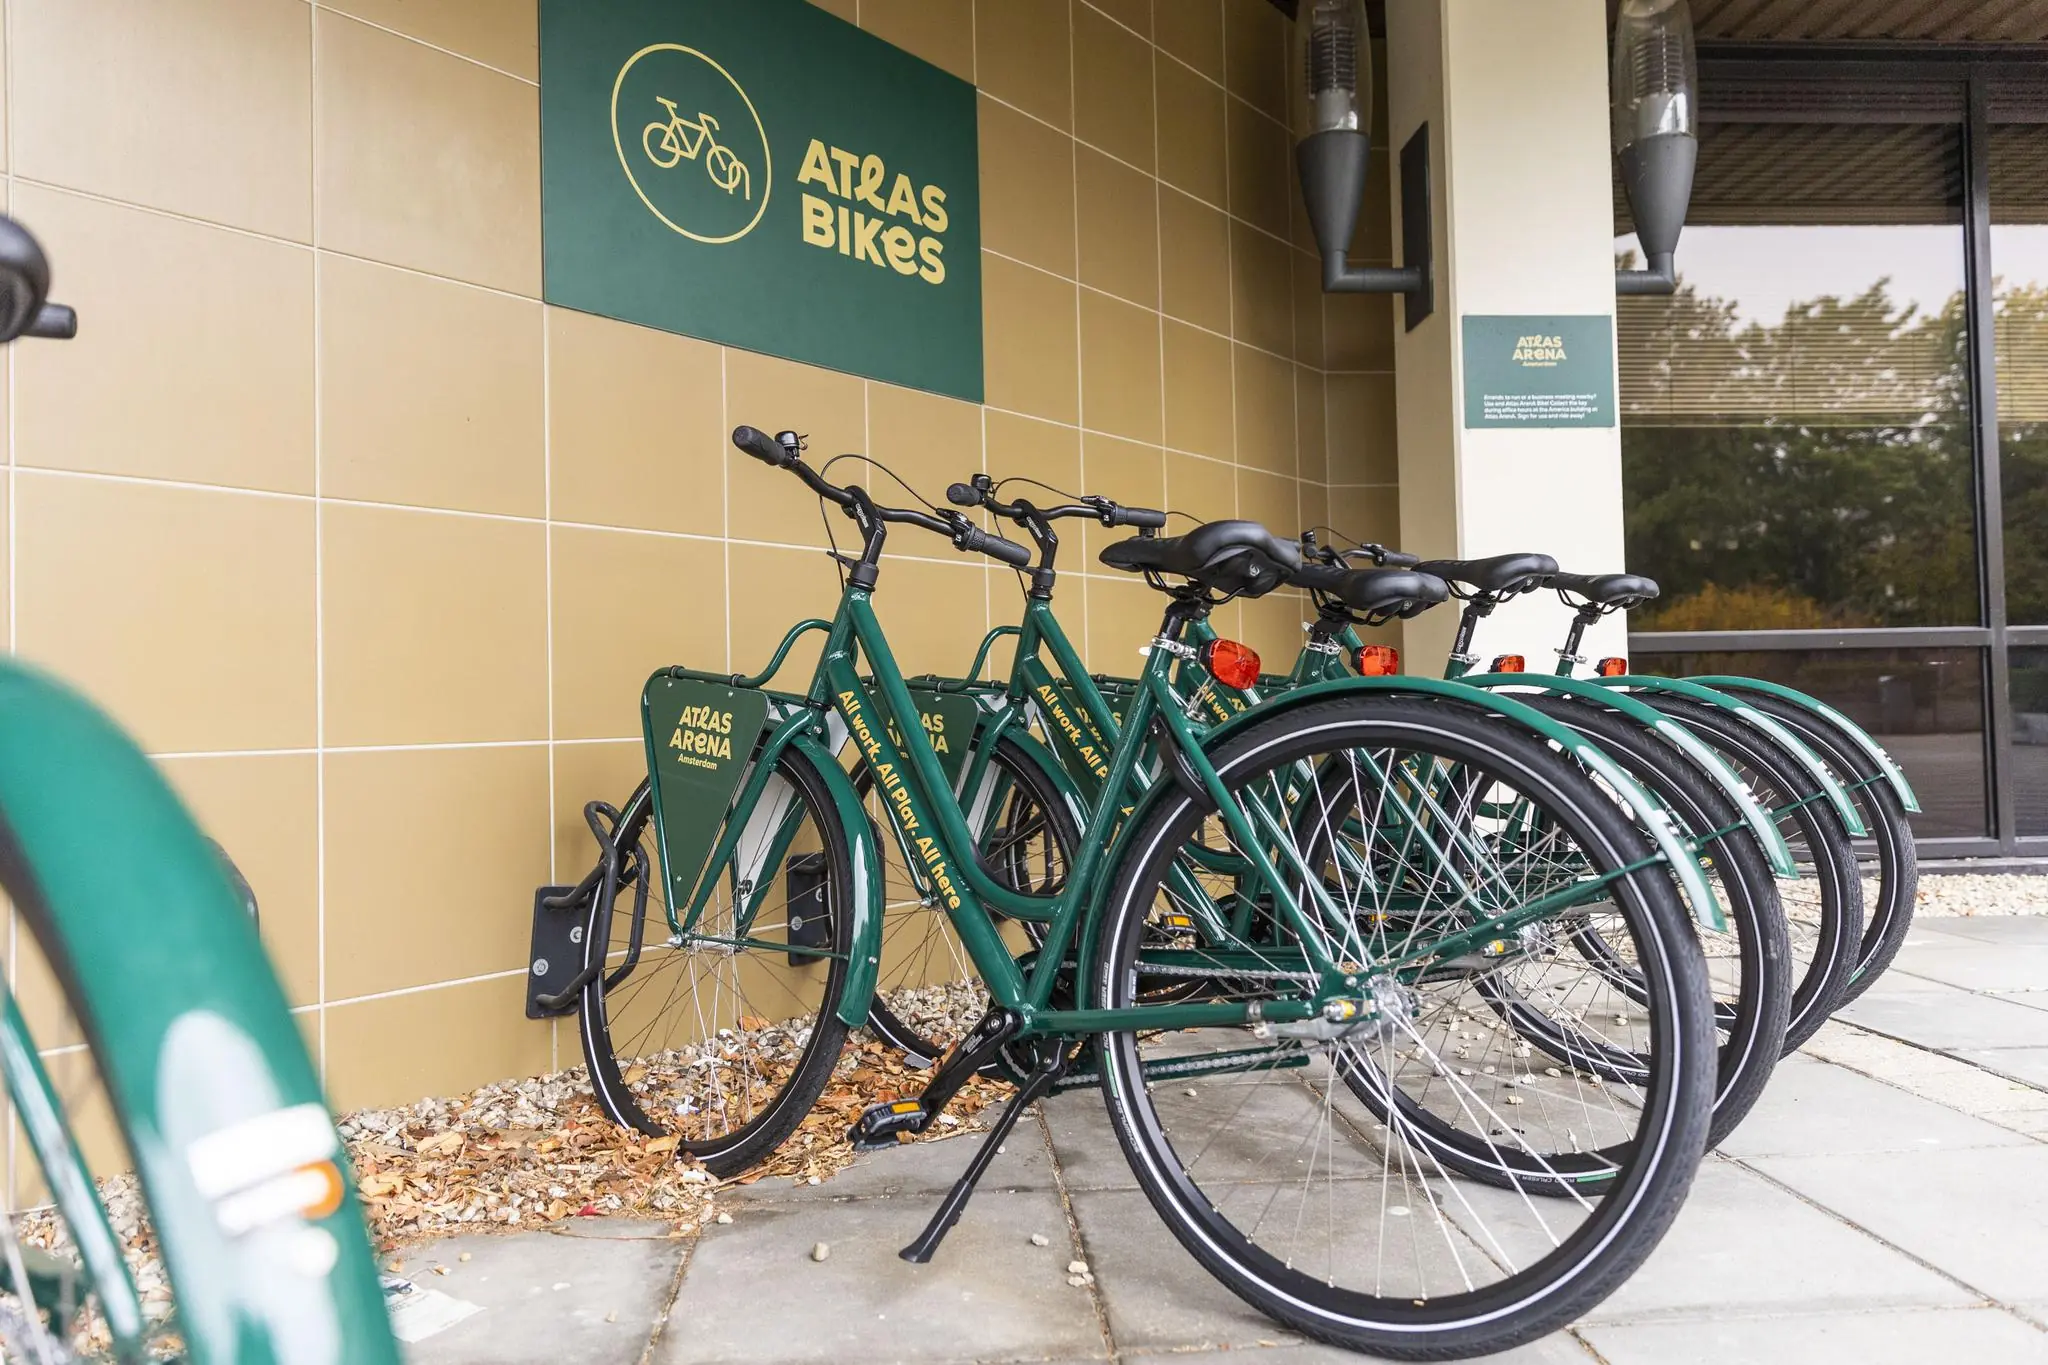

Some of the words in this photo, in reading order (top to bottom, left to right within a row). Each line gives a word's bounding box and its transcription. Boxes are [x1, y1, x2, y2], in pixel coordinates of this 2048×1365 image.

[677, 752, 718, 770] Amsterdam
[1036, 684, 1059, 706] All
[1052, 704, 1081, 746] work.
[1079, 745, 1102, 768] All
[838, 690, 862, 716] All
[851, 713, 882, 763] work.
[876, 763, 901, 800] All
[915, 837, 942, 864] All
[931, 861, 961, 910] here
